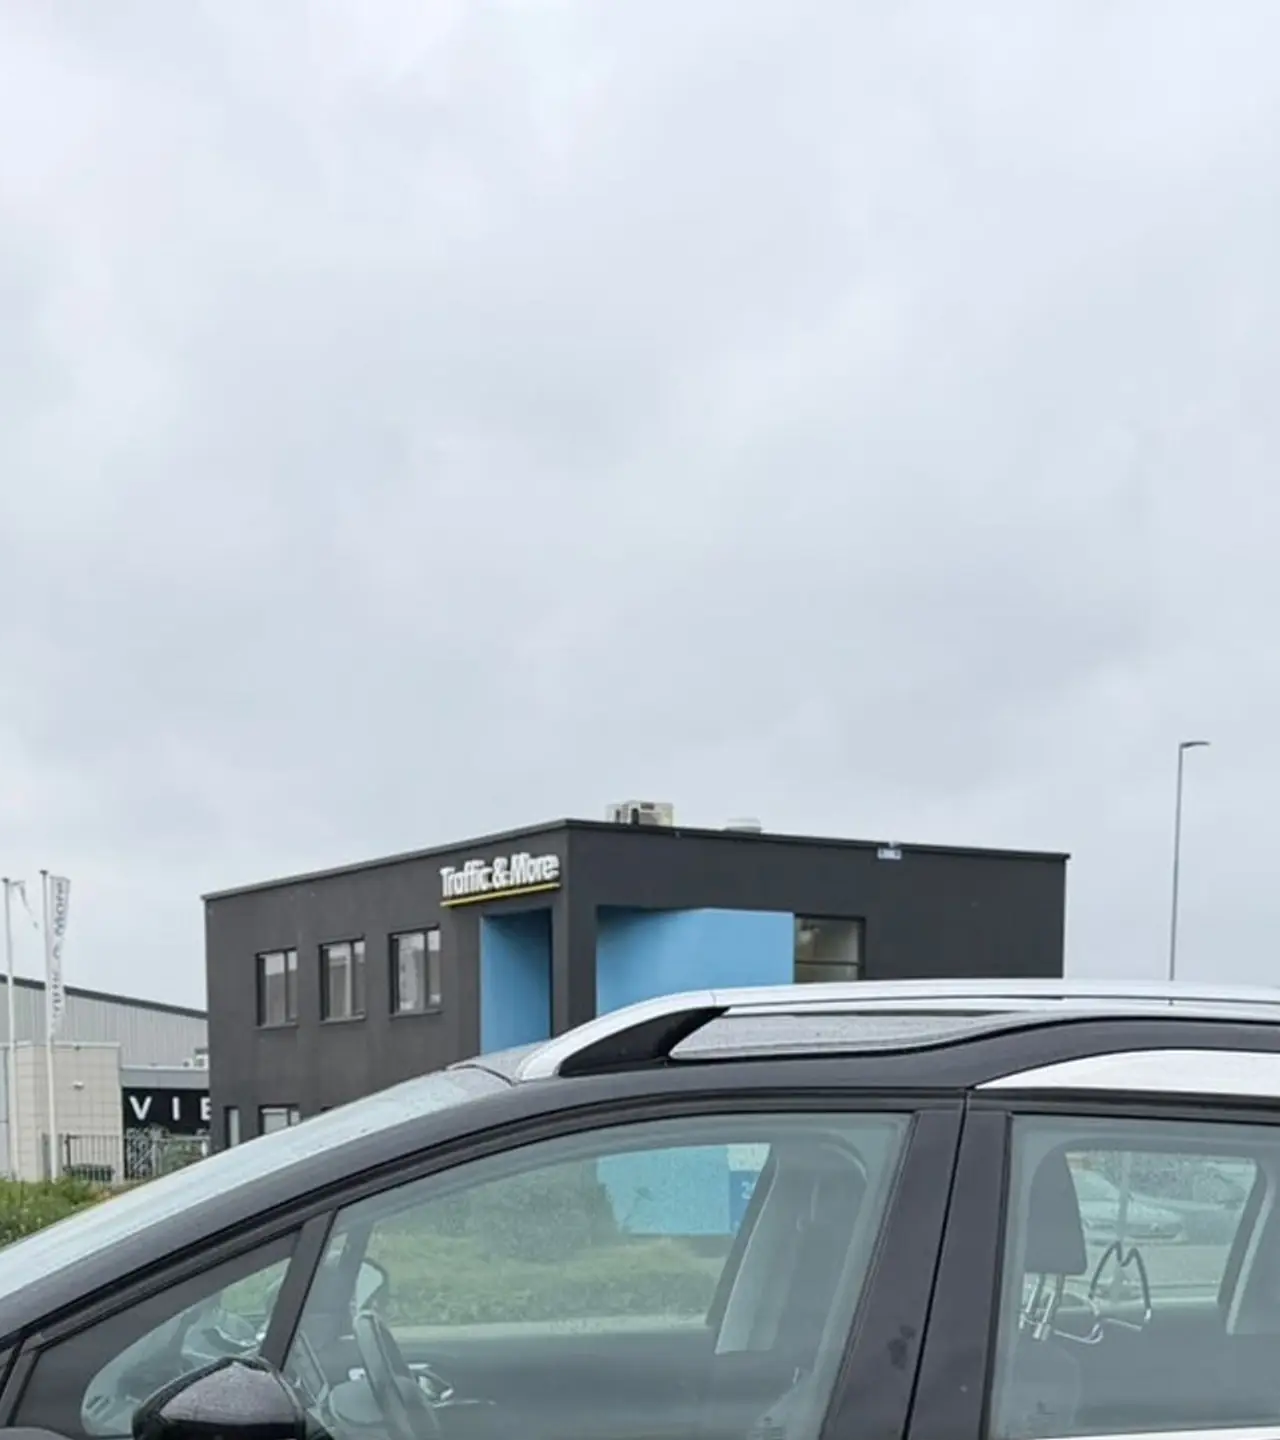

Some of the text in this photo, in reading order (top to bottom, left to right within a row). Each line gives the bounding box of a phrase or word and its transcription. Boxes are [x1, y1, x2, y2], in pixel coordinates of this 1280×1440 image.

[440, 852, 559, 898] Traffic & More
